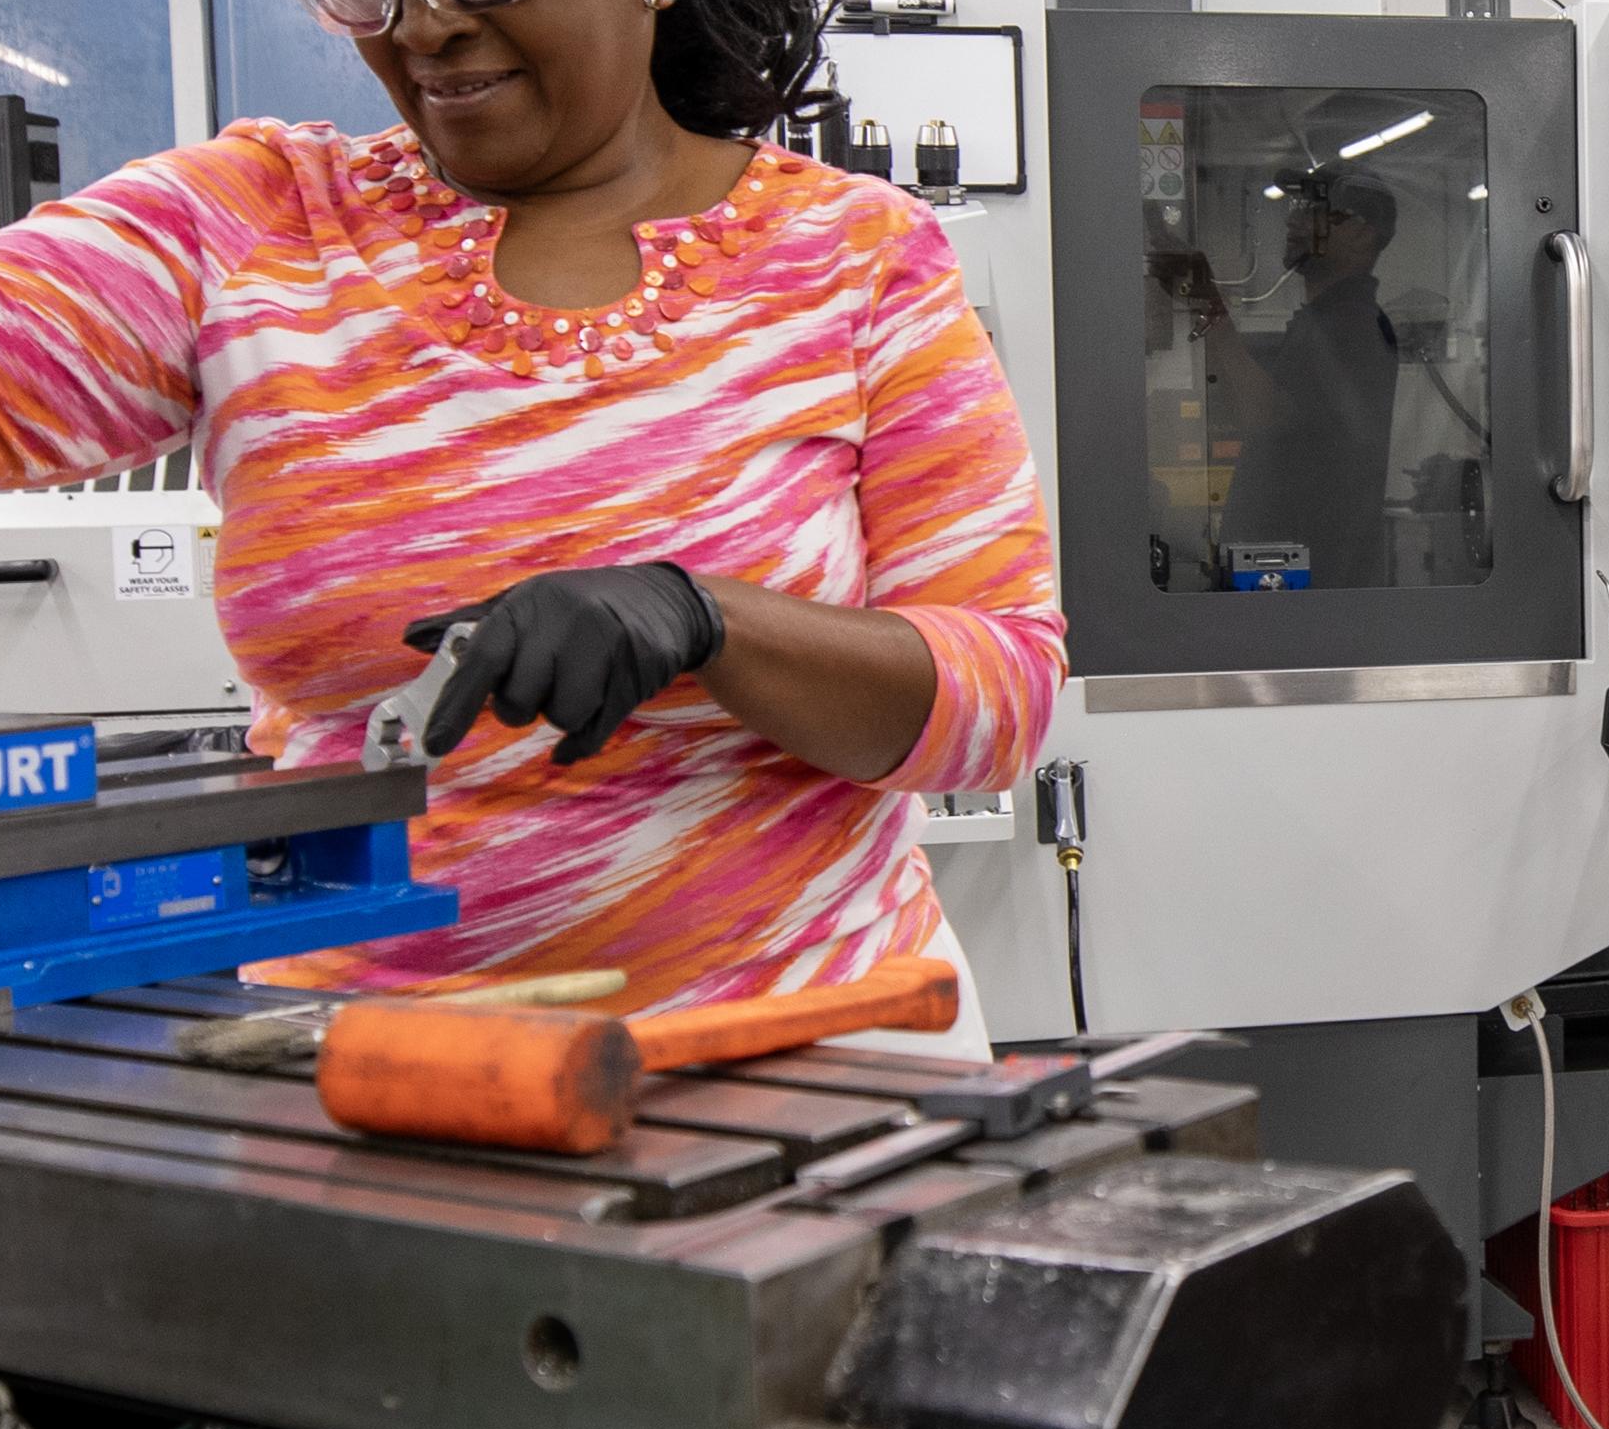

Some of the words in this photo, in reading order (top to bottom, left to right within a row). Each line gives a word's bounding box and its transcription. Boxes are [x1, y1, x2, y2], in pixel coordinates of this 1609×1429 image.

[128, 577, 153, 585] WEAR
[155, 576, 179, 584] YOUR
[119, 586, 150, 594] SAFETY
[152, 585, 190, 593] GLASSES
